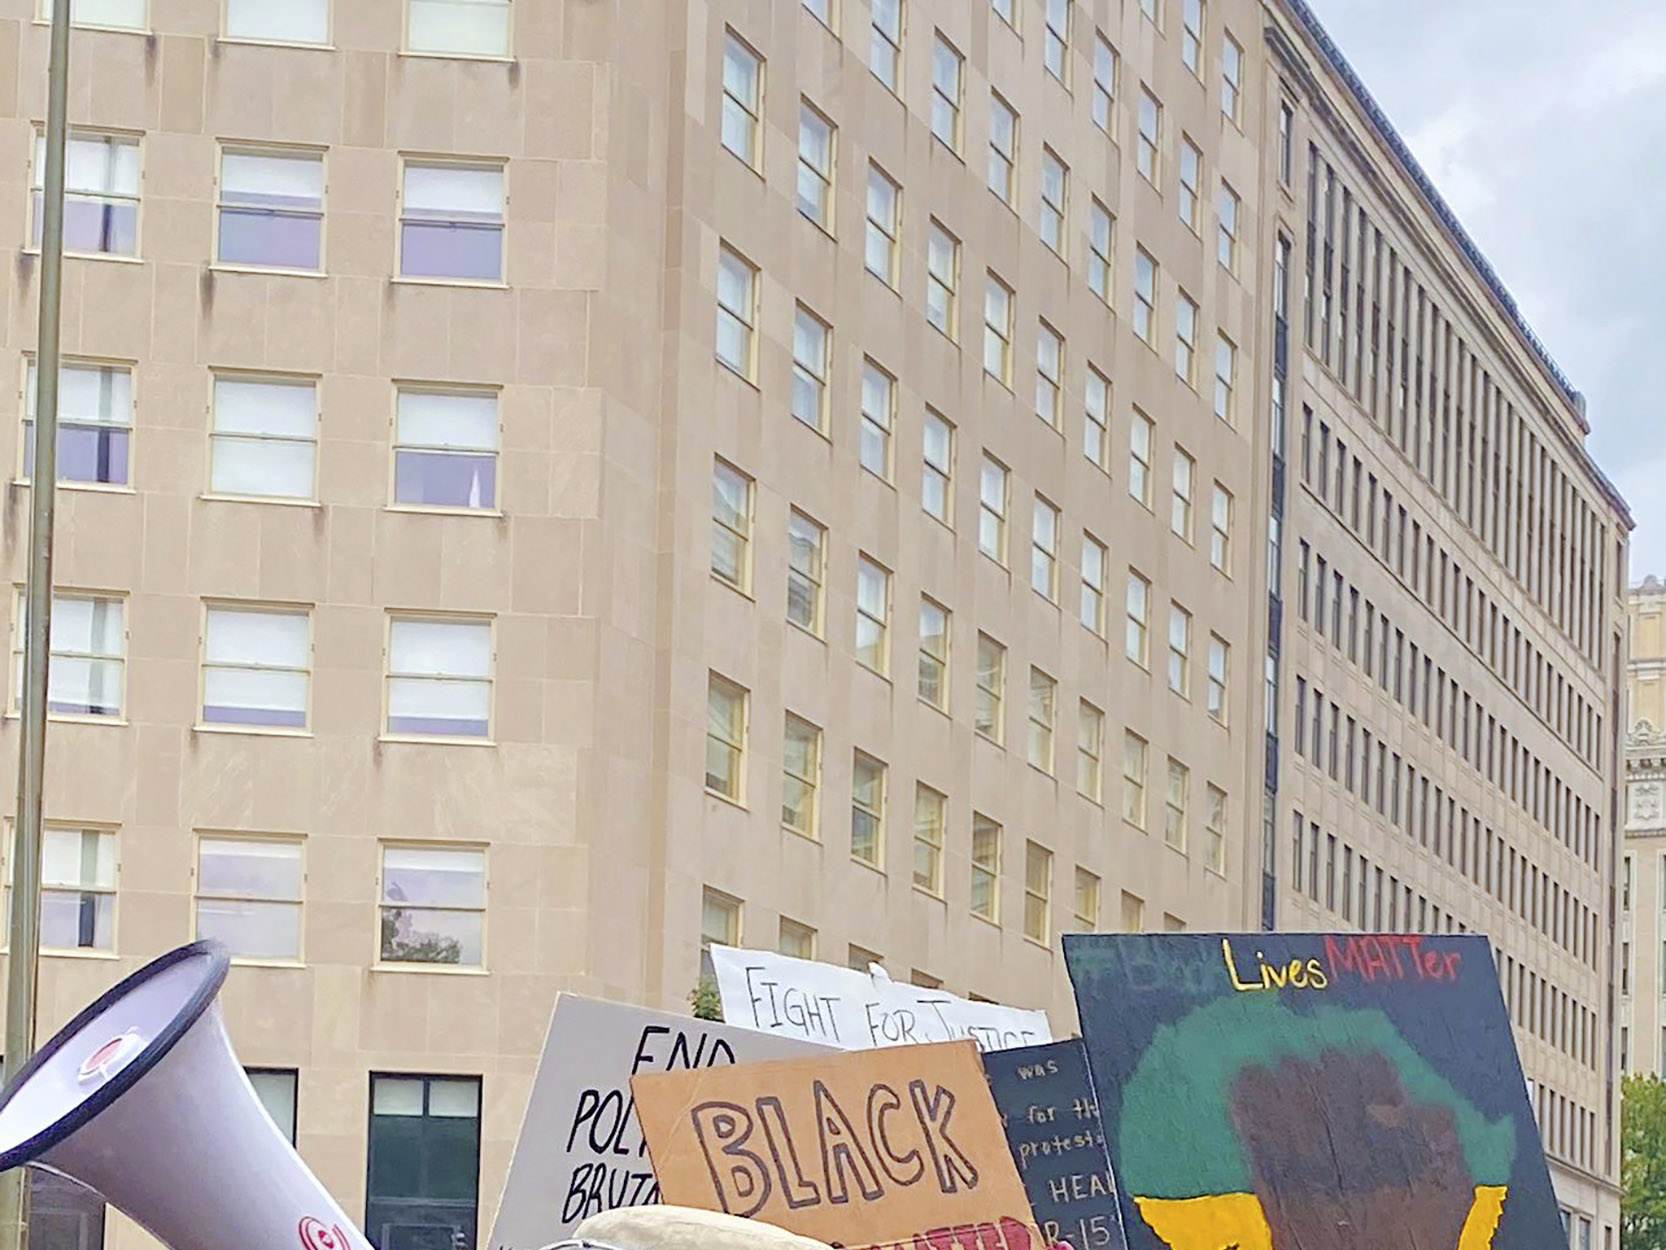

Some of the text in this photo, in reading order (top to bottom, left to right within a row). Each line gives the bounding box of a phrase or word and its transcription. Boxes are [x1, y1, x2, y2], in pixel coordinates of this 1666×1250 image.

[1222, 938, 1328, 991] Lives
[745, 966, 841, 1042] FIGHT
[866, 1002, 918, 1047] FOR
[1018, 1060, 1058, 1080] was
[566, 1089, 648, 1158] POL
[1028, 1105, 1055, 1124] for
[691, 1079, 979, 1219] BLACK
